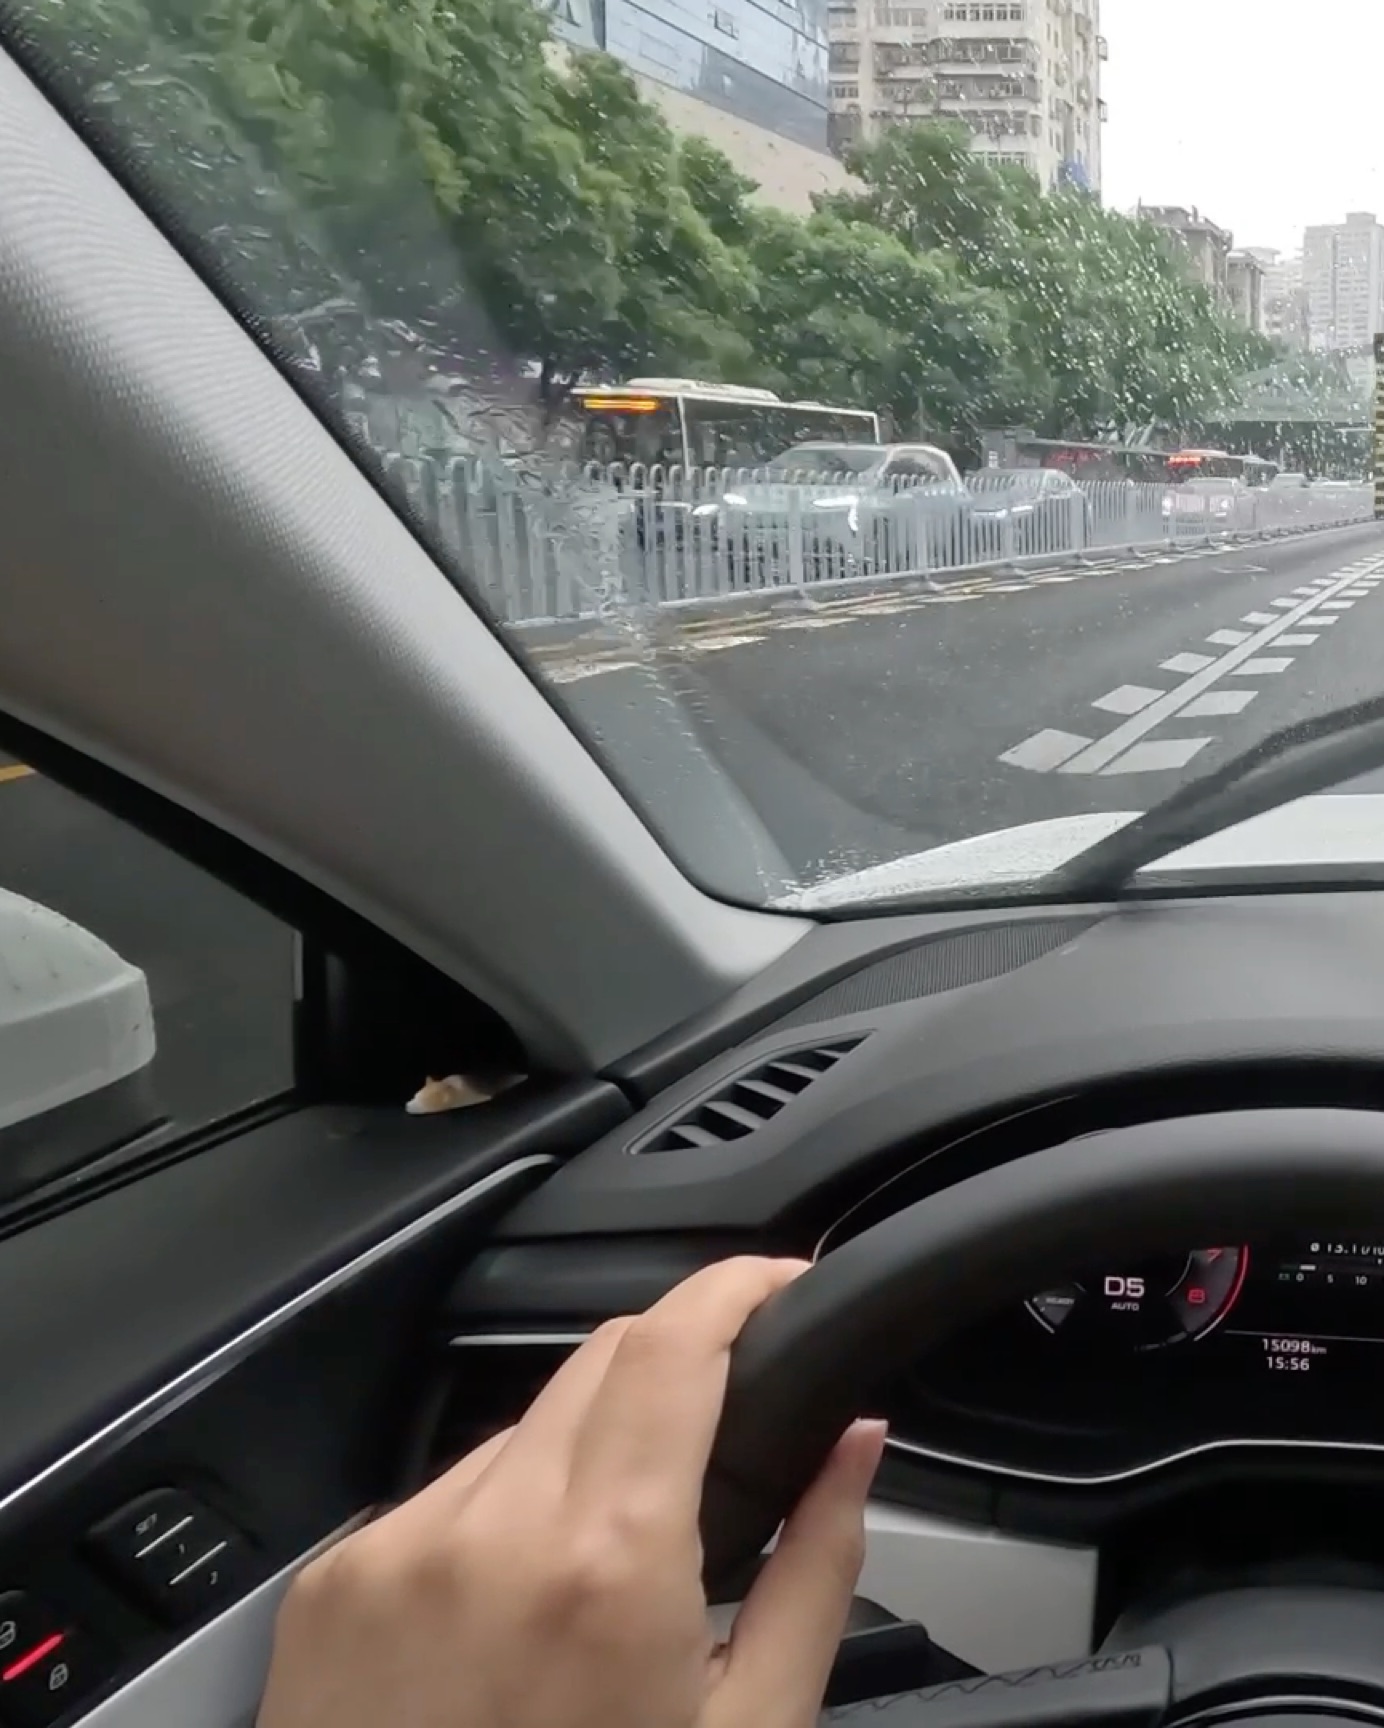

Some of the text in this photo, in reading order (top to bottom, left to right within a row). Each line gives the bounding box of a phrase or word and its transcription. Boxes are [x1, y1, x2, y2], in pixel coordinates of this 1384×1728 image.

[1295, 1272, 1305, 1282] 0
[1327, 1273, 1334, 1284] 5
[1355, 1275, 1368, 1286] 10
[1104, 1276, 1145, 1298] D5
[1111, 1302, 1140, 1312] AUTO
[1266, 1356, 1310, 1371] 15:56
